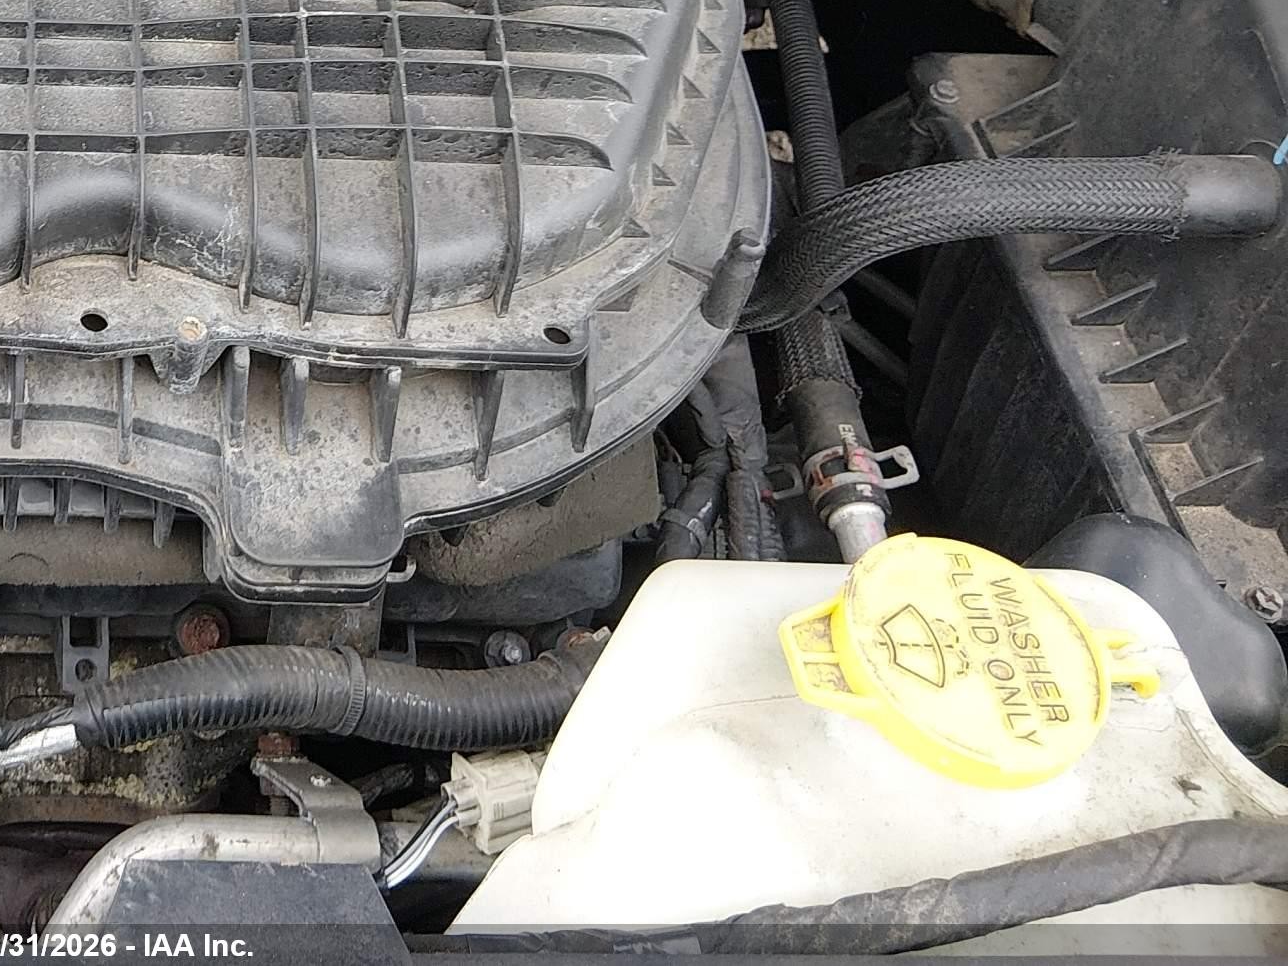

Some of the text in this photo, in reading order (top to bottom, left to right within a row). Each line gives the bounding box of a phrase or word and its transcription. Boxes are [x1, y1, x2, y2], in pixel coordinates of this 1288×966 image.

[943, 553, 1042, 746] FLUID ONLY
[989, 576, 1070, 723] WASHER
